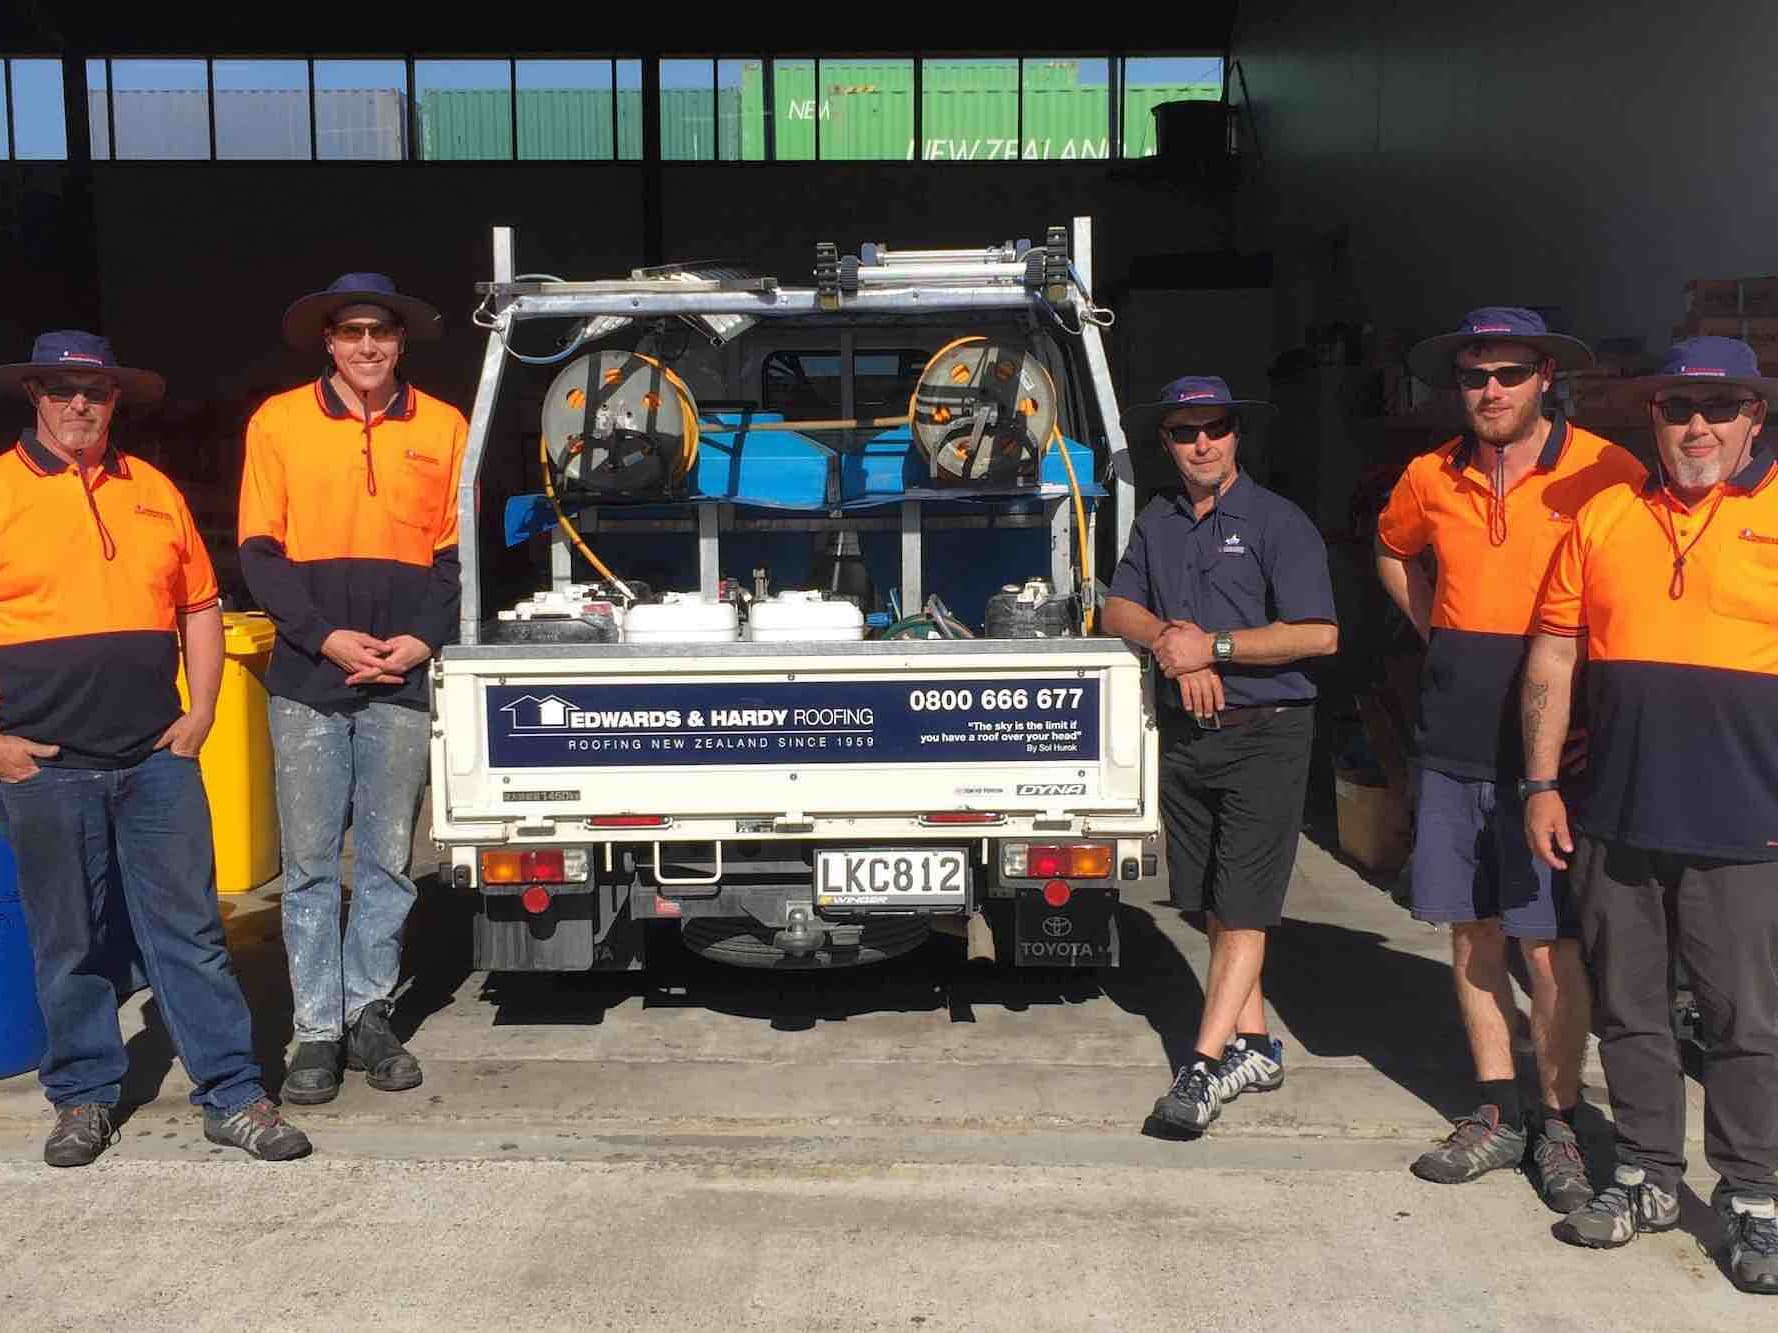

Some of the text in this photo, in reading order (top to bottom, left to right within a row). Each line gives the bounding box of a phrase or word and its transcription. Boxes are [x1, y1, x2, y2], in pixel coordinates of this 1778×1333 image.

[910, 688, 1084, 711] 0800 666 677
[570, 708, 874, 728] EDWARDS & HARDY ROOFING
[995, 720, 1013, 733] sky
[1015, 720, 1025, 730] is
[1027, 720, 1043, 730] the
[1046, 719, 1068, 729] limit
[1070, 719, 1078, 729] if
[568, 735, 874, 751] ROOFING NEW ZEALAND SINCE 1959
[920, 734, 939, 744] you
[942, 733, 966, 742] have
[978, 732, 999, 741] roof
[1001, 732, 1024, 741] over
[1026, 732, 1049, 742] your
[1026, 744, 1037, 753] By
[1018, 784, 1085, 796] DYNA
[822, 857, 960, 893] LKC812
[1020, 941, 1094, 957] TOYOTA
